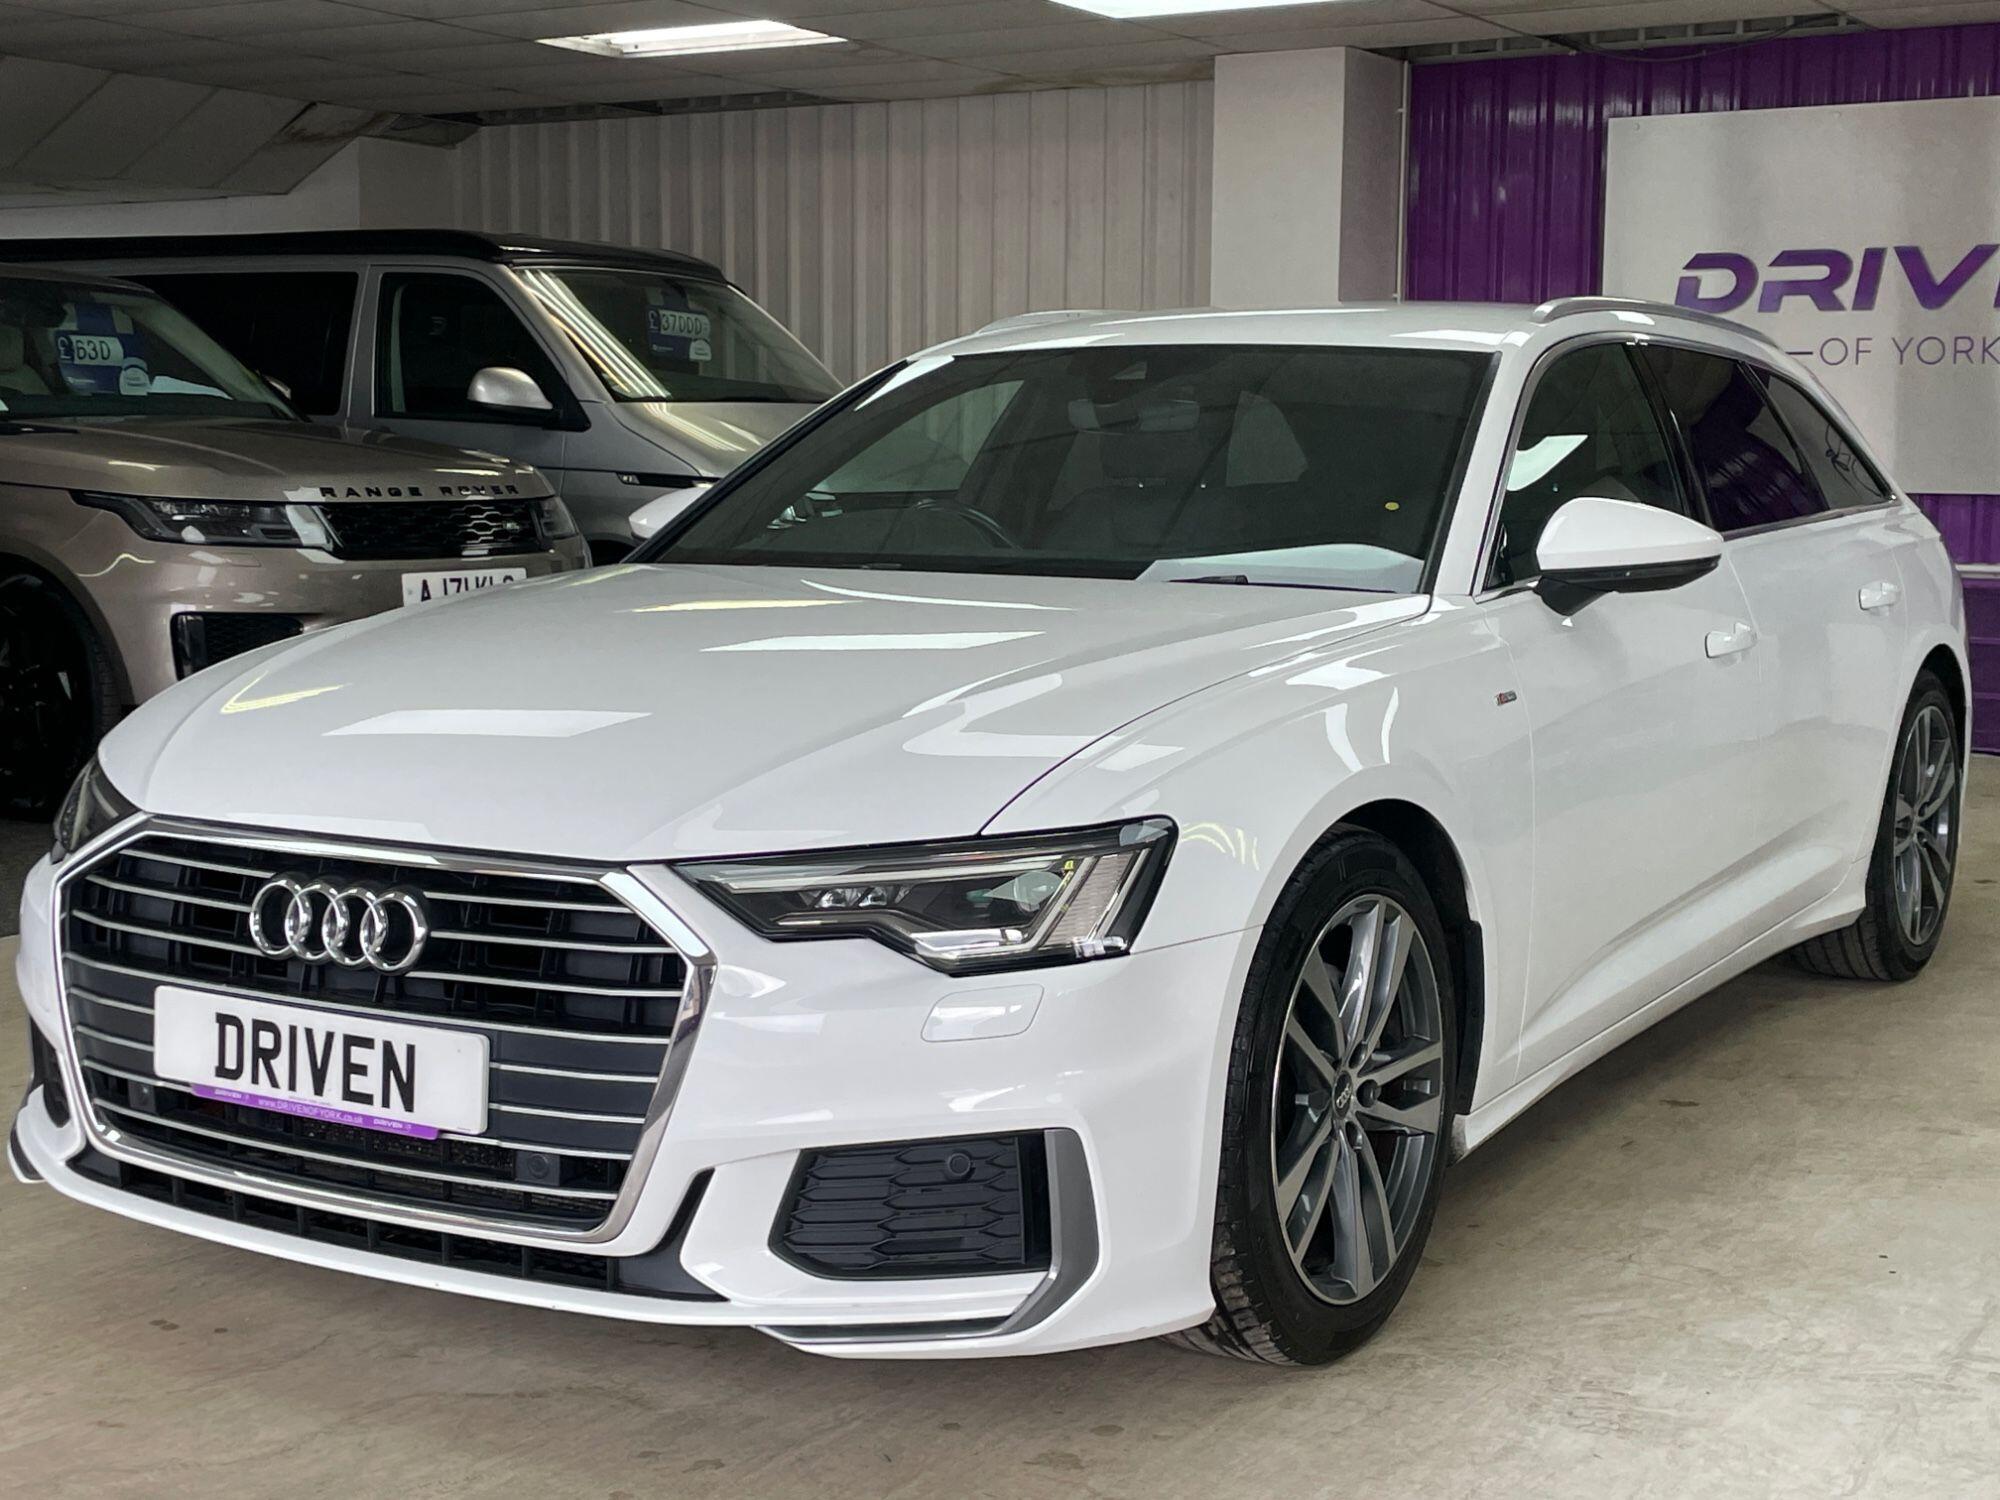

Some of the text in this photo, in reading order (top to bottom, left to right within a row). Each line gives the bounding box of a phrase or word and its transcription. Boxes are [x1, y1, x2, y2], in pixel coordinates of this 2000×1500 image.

[1675, 244, 2000, 314] DRIV
[1820, 337, 1873, 366] OF
[319, 485, 519, 498] RANGE ROVER
[215, 1012, 415, 1112] DRIVEN
